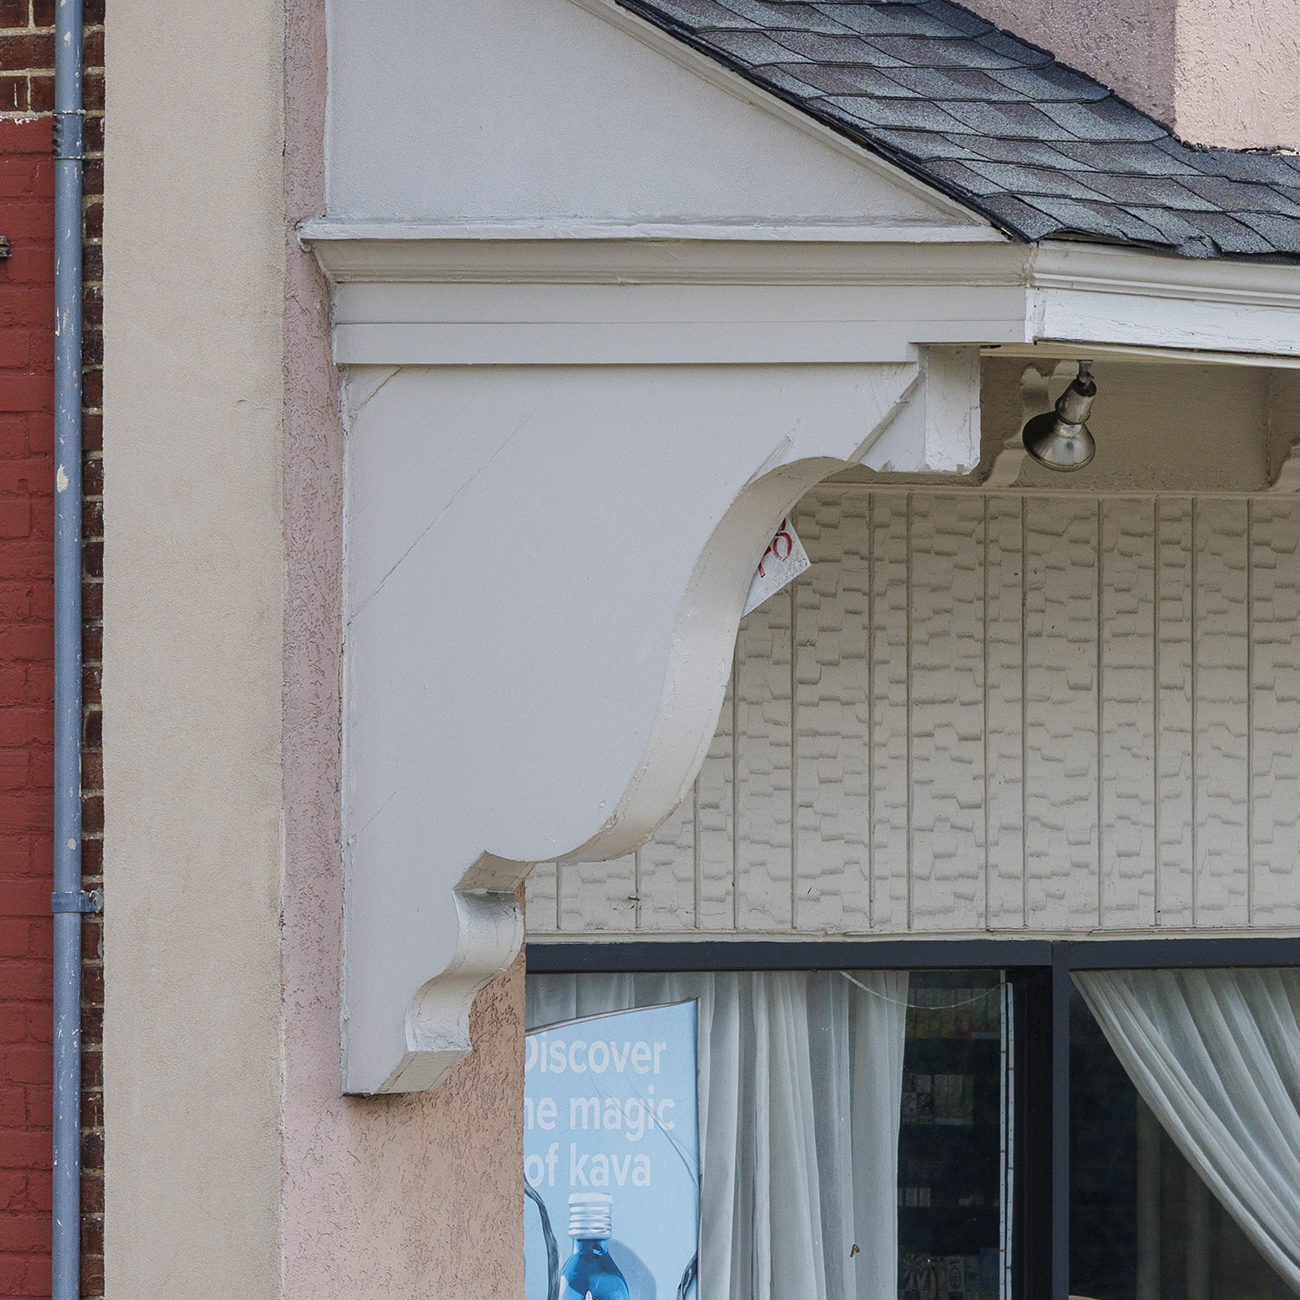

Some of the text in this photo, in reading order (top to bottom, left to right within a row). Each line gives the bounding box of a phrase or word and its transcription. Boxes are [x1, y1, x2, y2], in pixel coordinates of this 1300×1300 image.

[570, 1084, 675, 1142] magic
[525, 1142, 650, 1187] of kava
